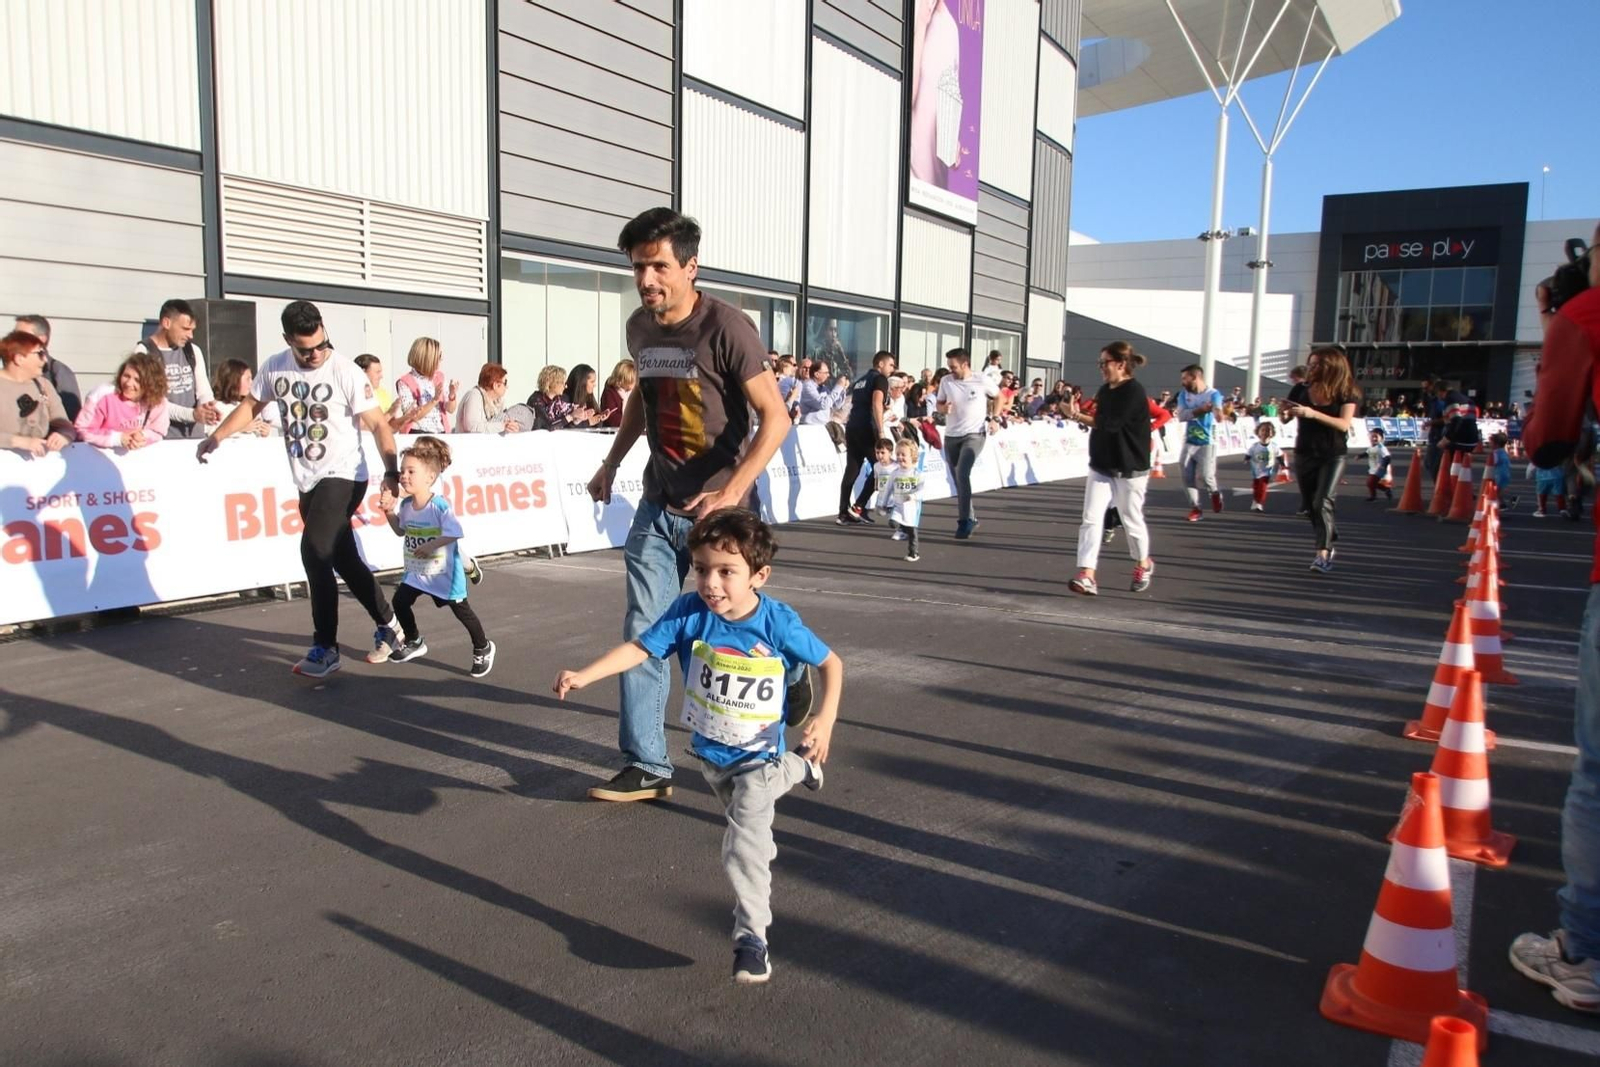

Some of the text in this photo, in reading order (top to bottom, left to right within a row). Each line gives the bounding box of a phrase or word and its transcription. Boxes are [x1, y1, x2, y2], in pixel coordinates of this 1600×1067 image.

[640, 355, 692, 373] Germany
[476, 463, 544, 478] SPORT & SHOES
[26, 489, 156, 510] SPORT & SHOES
[700, 663, 774, 702] 8176
[706, 692, 756, 710] ALEJANDRO
